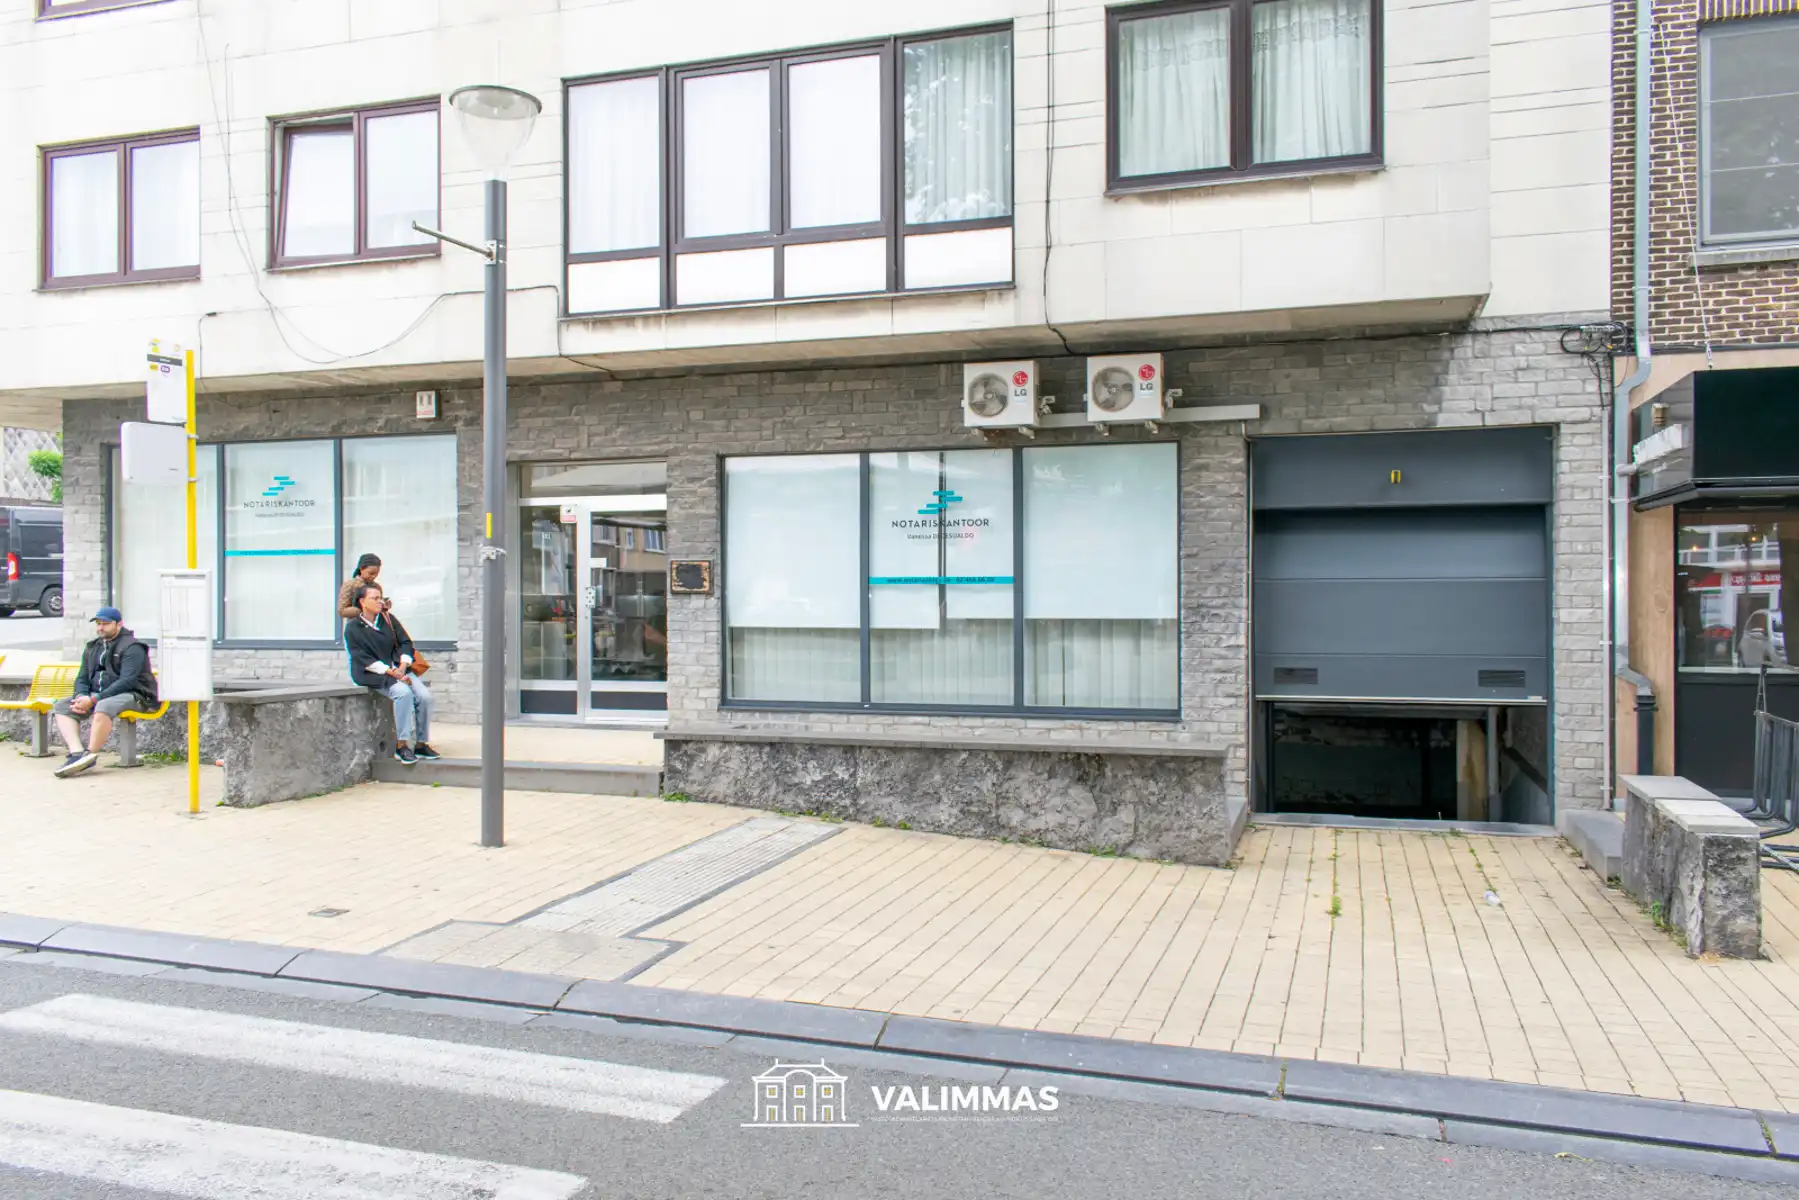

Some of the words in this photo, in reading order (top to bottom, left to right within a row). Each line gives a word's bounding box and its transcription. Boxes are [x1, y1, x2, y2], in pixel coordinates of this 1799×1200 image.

[1140, 383, 1153, 391] LG
[1014, 389, 1027, 397] LG
[243, 500, 315, 508] NOTARISKANTOOR
[892, 519, 989, 528] NOTARISKANTOOR
